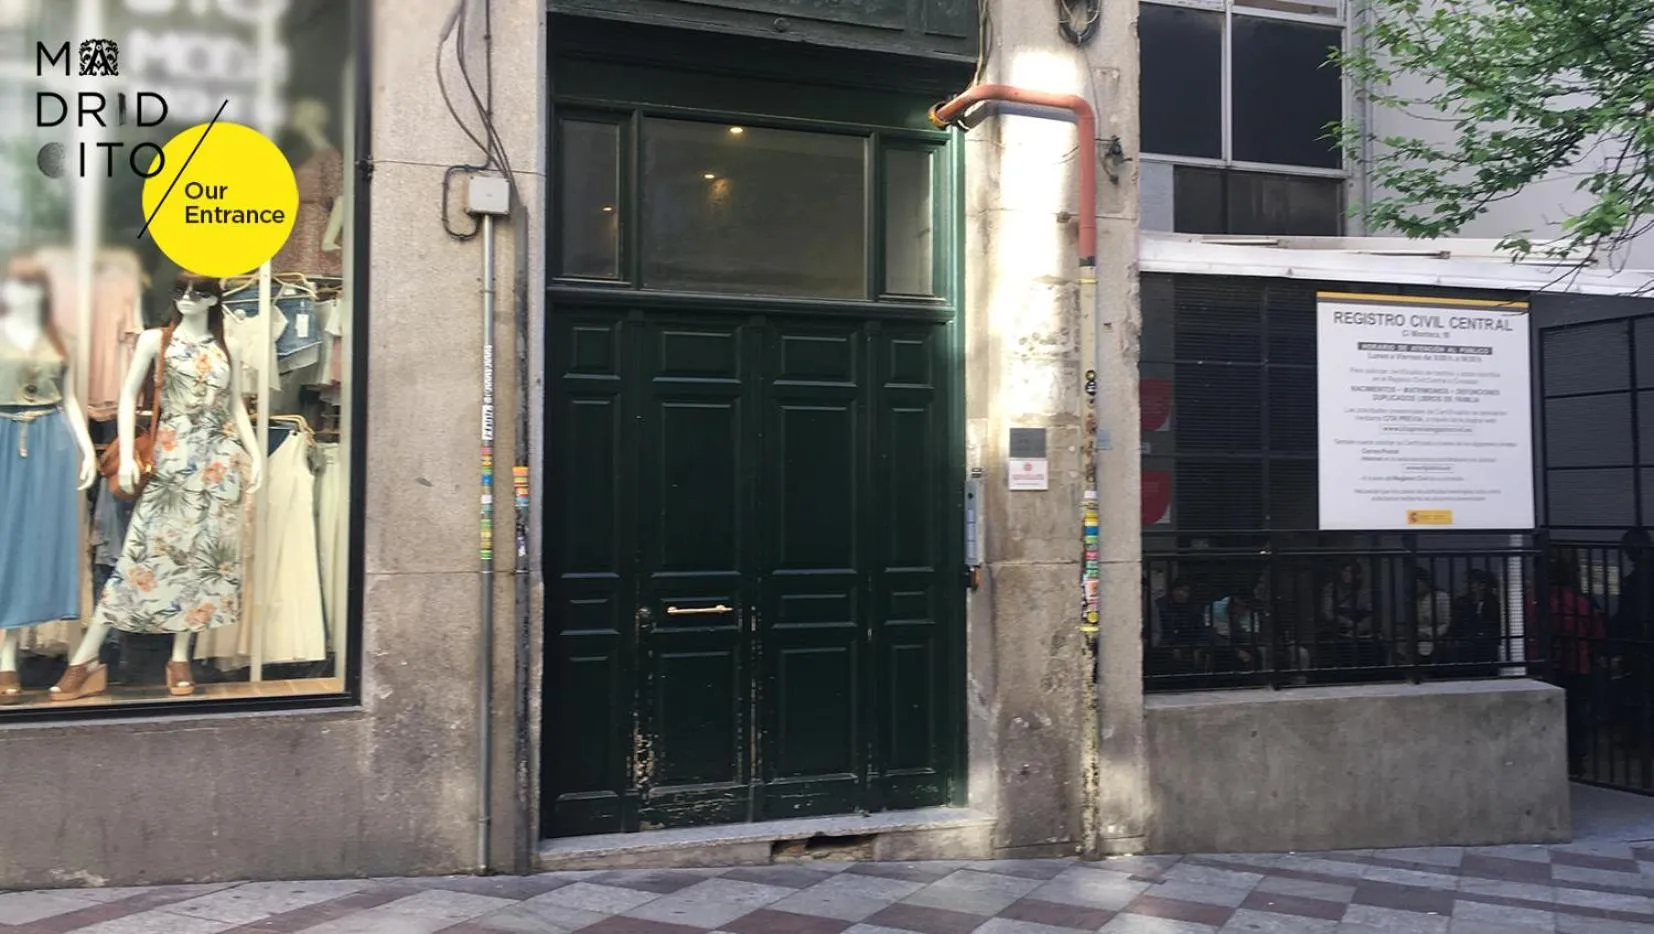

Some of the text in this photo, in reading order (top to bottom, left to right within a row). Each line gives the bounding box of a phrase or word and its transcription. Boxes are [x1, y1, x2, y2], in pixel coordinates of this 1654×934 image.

[1333, 311, 1514, 332] REGISTRO CIVIL CENTRAL
